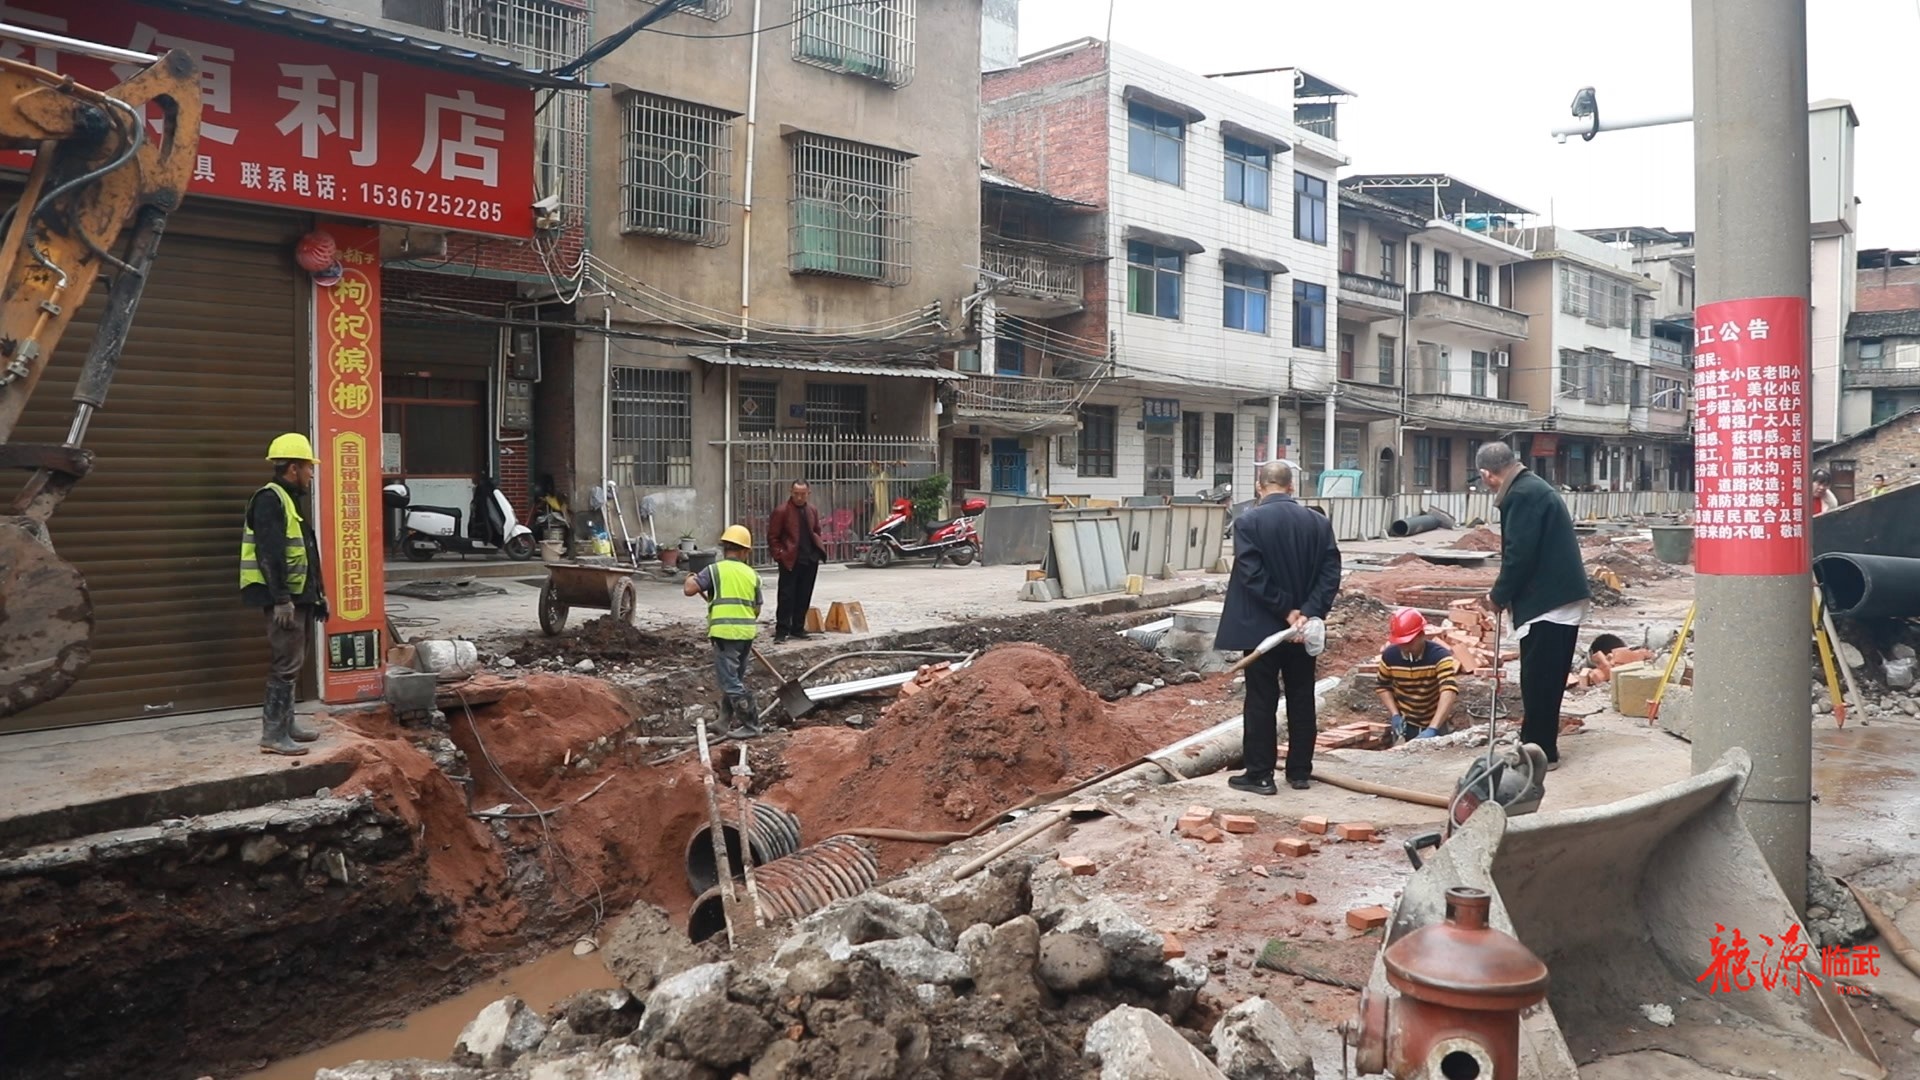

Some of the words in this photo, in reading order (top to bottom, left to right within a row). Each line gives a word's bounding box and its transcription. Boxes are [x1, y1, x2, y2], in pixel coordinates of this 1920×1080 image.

[0, 3, 506, 188] 便利店
[334, 277, 367, 410] 枸杞槟榔
